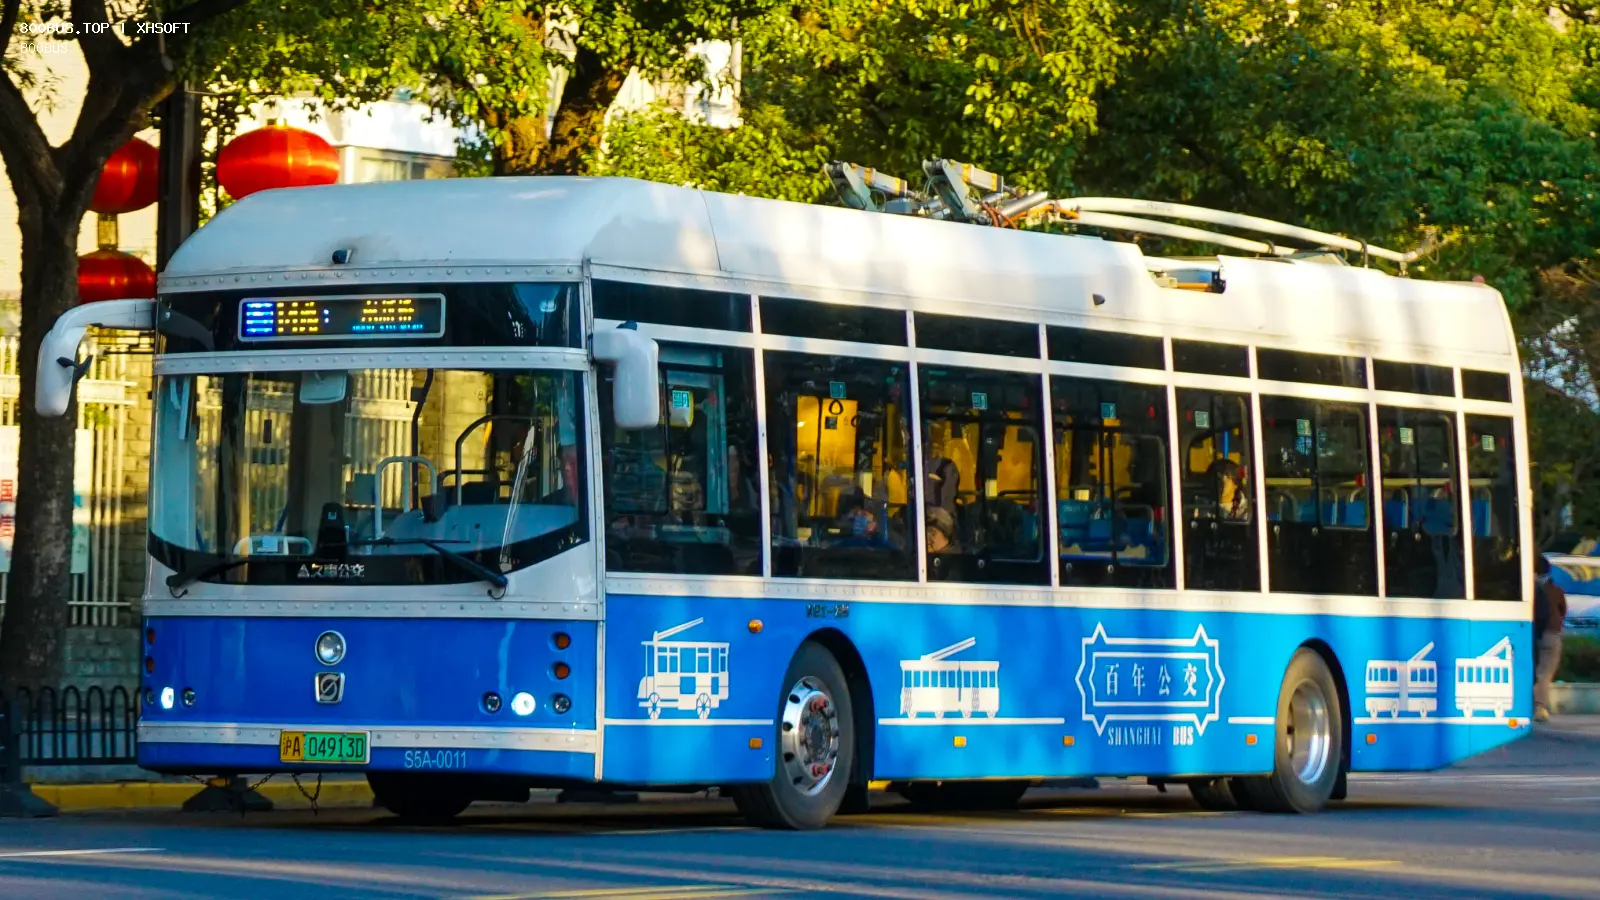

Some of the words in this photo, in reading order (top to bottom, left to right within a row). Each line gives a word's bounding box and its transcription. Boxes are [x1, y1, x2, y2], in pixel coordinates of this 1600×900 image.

[1105, 663, 1197, 697] 百年公交
[1108, 726, 1161, 746] SHANGHAI
[1173, 726, 1194, 746] BUS
[404, 751, 466, 768] S5A-0011
